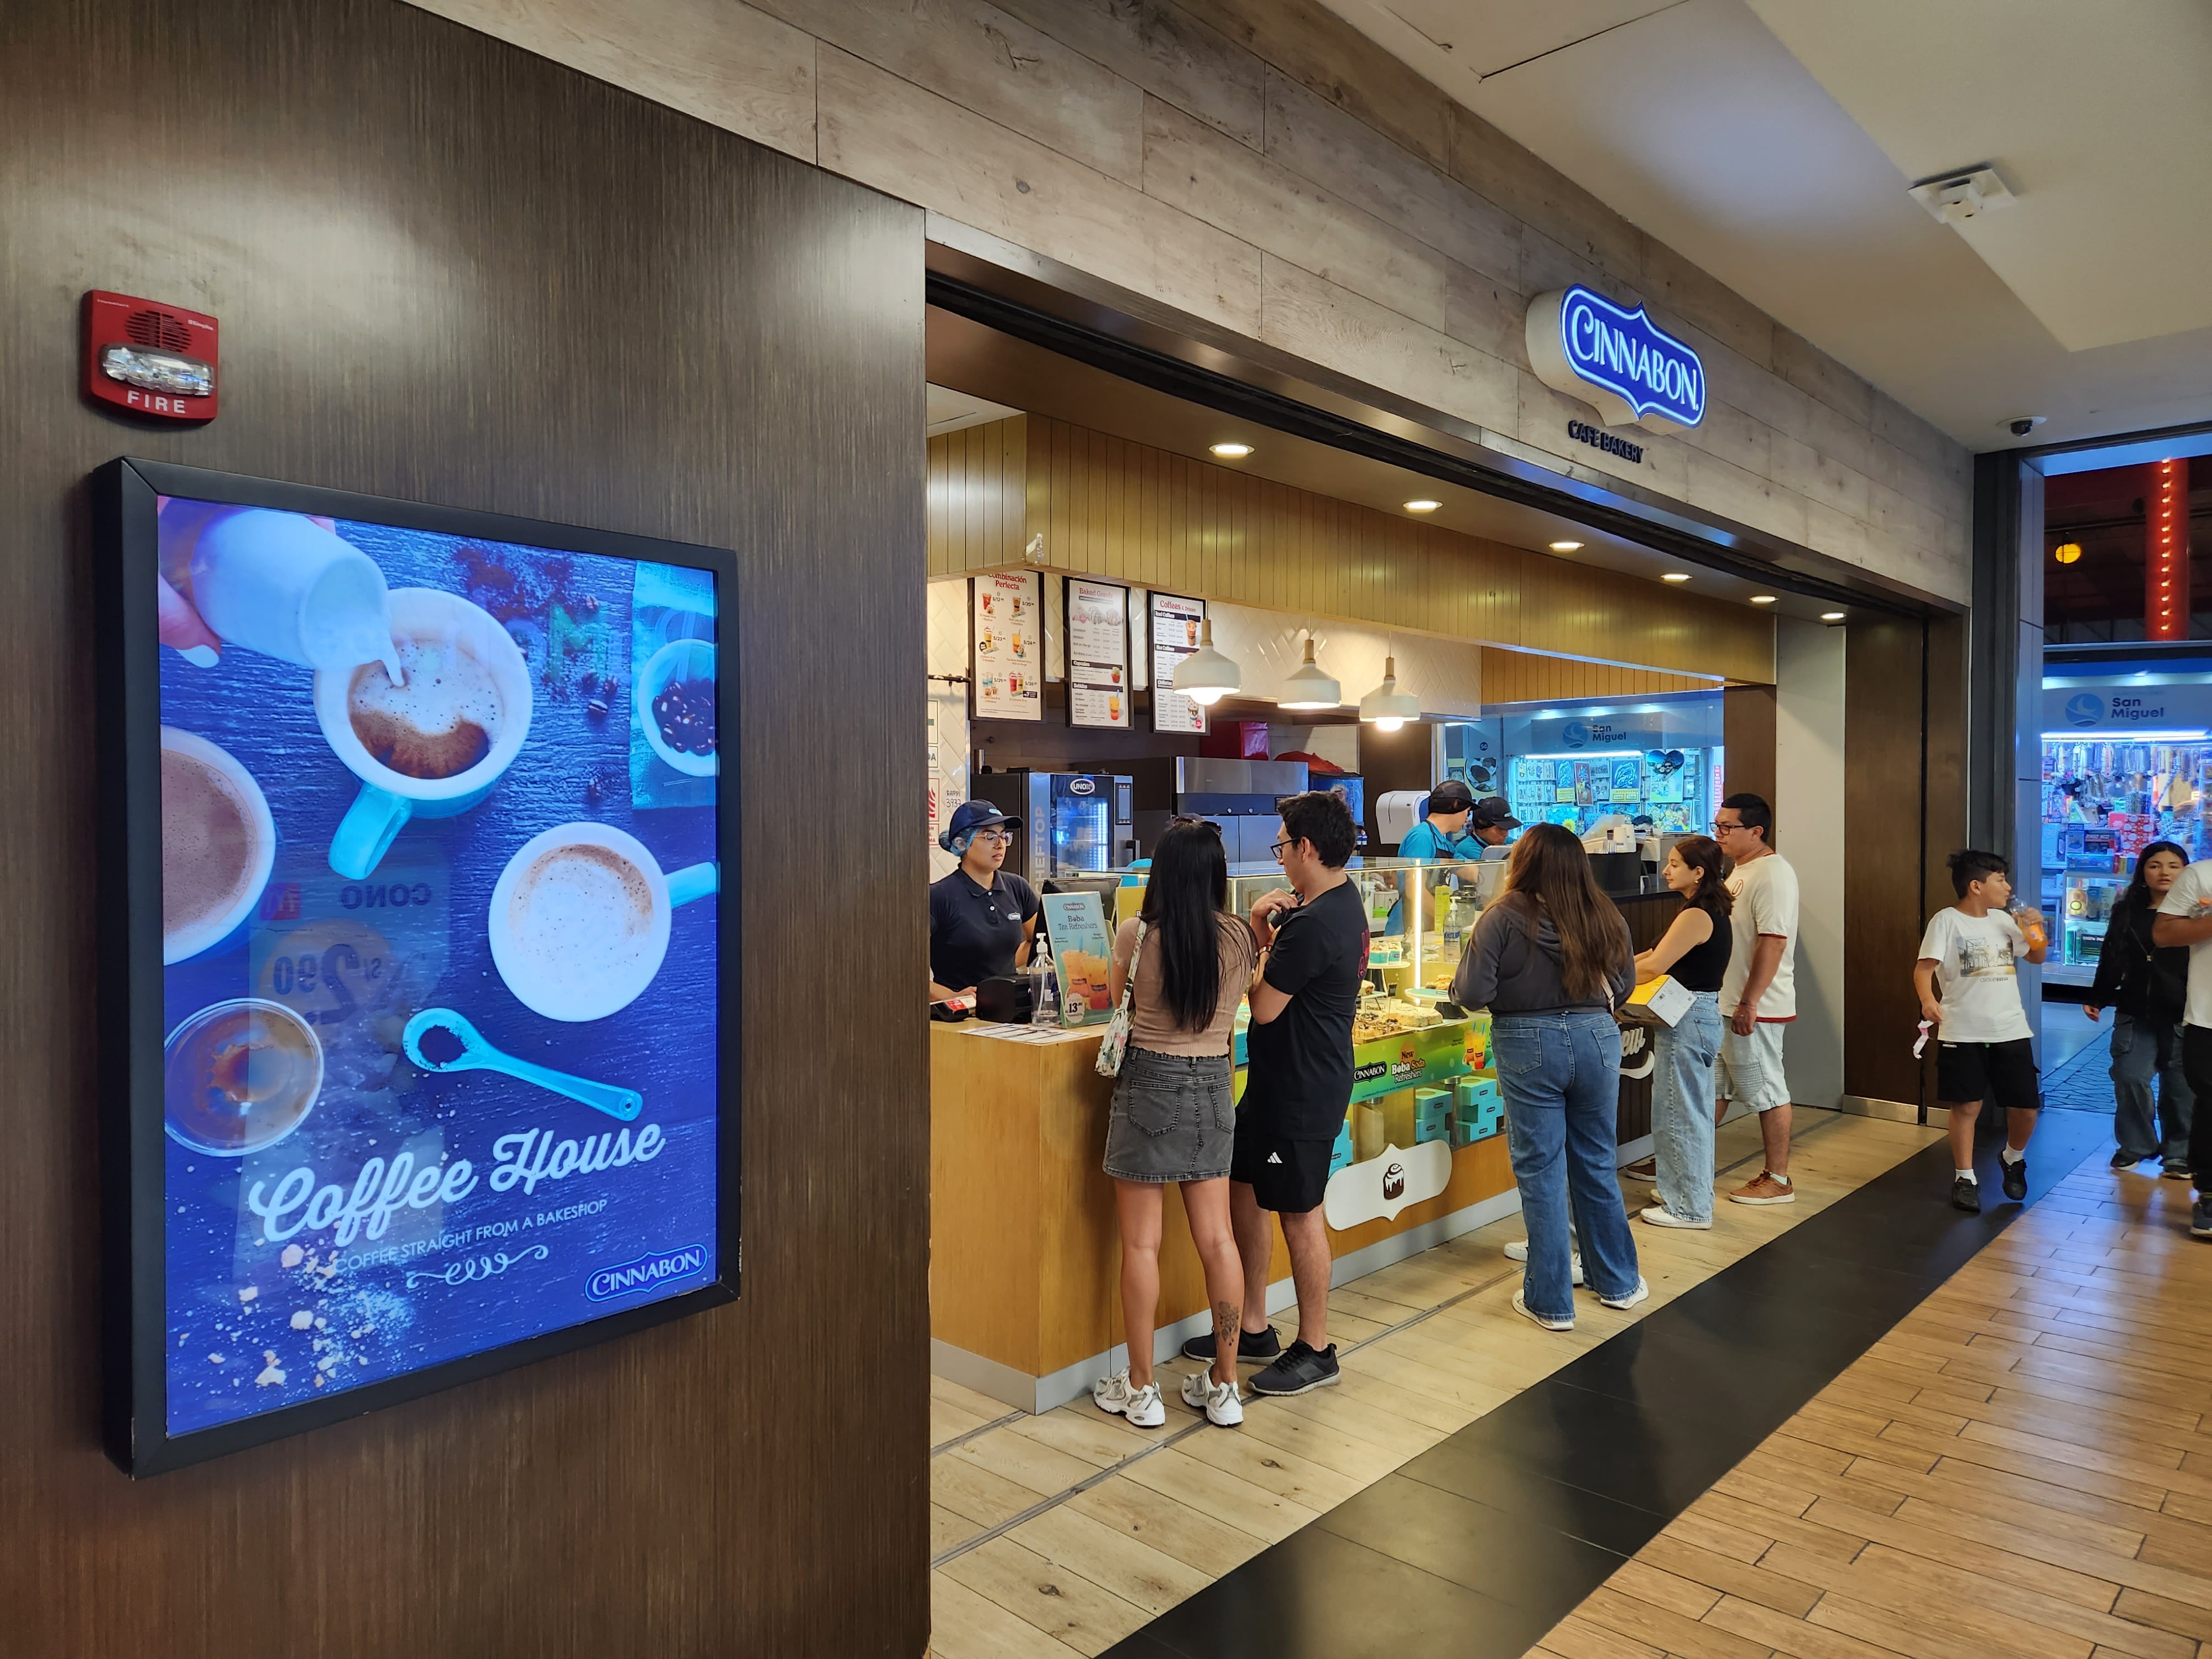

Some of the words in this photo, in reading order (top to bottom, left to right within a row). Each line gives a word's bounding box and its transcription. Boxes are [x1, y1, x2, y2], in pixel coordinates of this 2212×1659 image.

[1572, 304, 1698, 411] CINNABON
[127, 390, 186, 414] FIRE
[1568, 420, 1600, 447] CAFE
[1600, 432, 1644, 463] BAKERY
[995, 580, 1020, 590] Perfecta
[1079, 587, 1096, 596] Baked
[1097, 591, 1113, 599] Goods
[1160, 600, 1181, 610] Coffees
[2112, 697, 2141, 707] San
[2110, 707, 2164, 720] Miguel
[1592, 732, 1626, 743] Miguel
[946, 799, 961, 808] 3937
[1035, 806, 1046, 896] CHEFTOP
[1069, 922, 1098, 930] Refreshers
[1069, 1003, 1078, 1013] 13
[1401, 1051, 1414, 1060] New
[1354, 1064, 1385, 1081] CINNABON
[1391, 1062, 1411, 1075] Boba
[1411, 1058, 1426, 1069] Soda
[1395, 1070, 1423, 1083] Refreshers
[248, 1151, 479, 1248] Coffee
[490, 1123, 666, 1196] House
[335, 1246, 400, 1274] COFFEE
[400, 1229, 473, 1258] STRAIGHT
[476, 1219, 518, 1240] FROM
[522, 1217, 533, 1230] A
[536, 1199, 608, 1227] BAKESHOP
[592, 1250, 701, 1296] CINNABON
